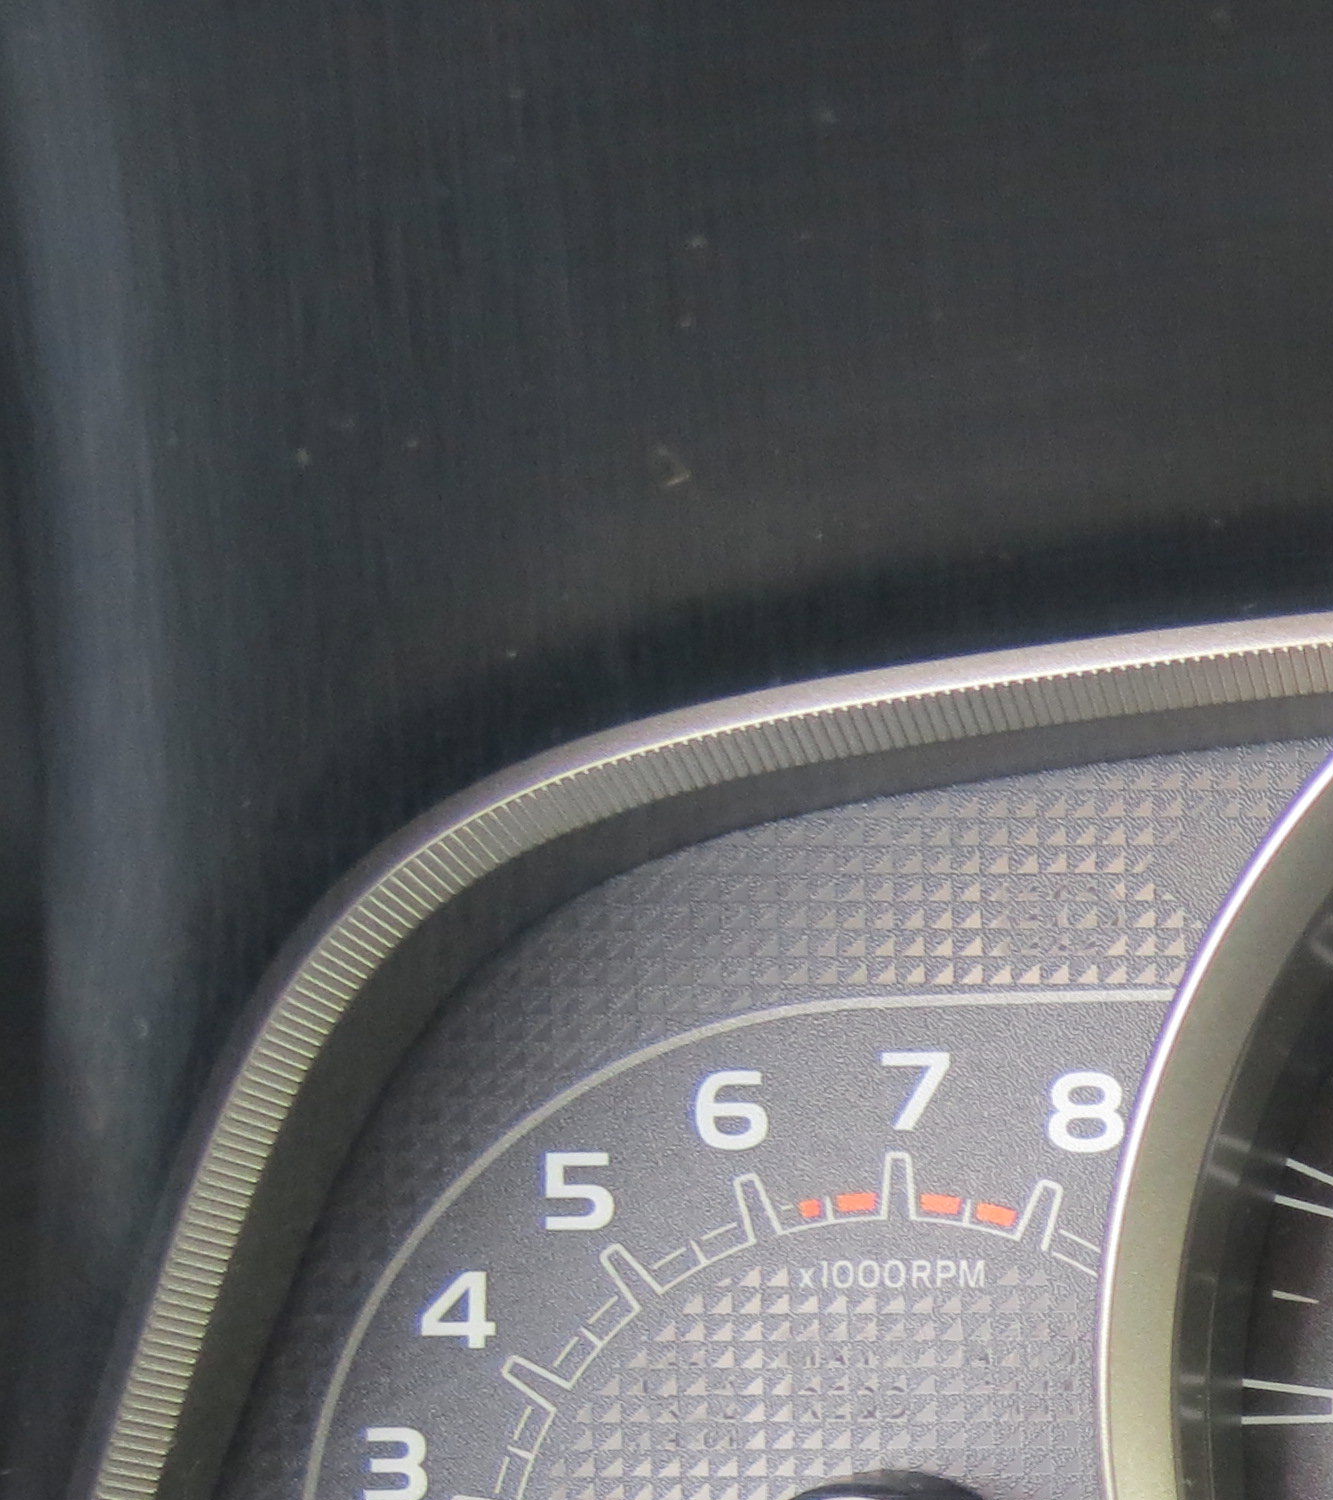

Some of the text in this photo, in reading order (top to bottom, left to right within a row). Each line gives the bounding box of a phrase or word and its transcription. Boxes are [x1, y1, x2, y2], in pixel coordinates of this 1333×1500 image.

[694, 1069, 769, 1151] 6
[880, 1050, 951, 1133] 7
[1047, 1071, 1124, 1154] 8
[545, 1151, 615, 1231] 5
[420, 1270, 497, 1349] 4
